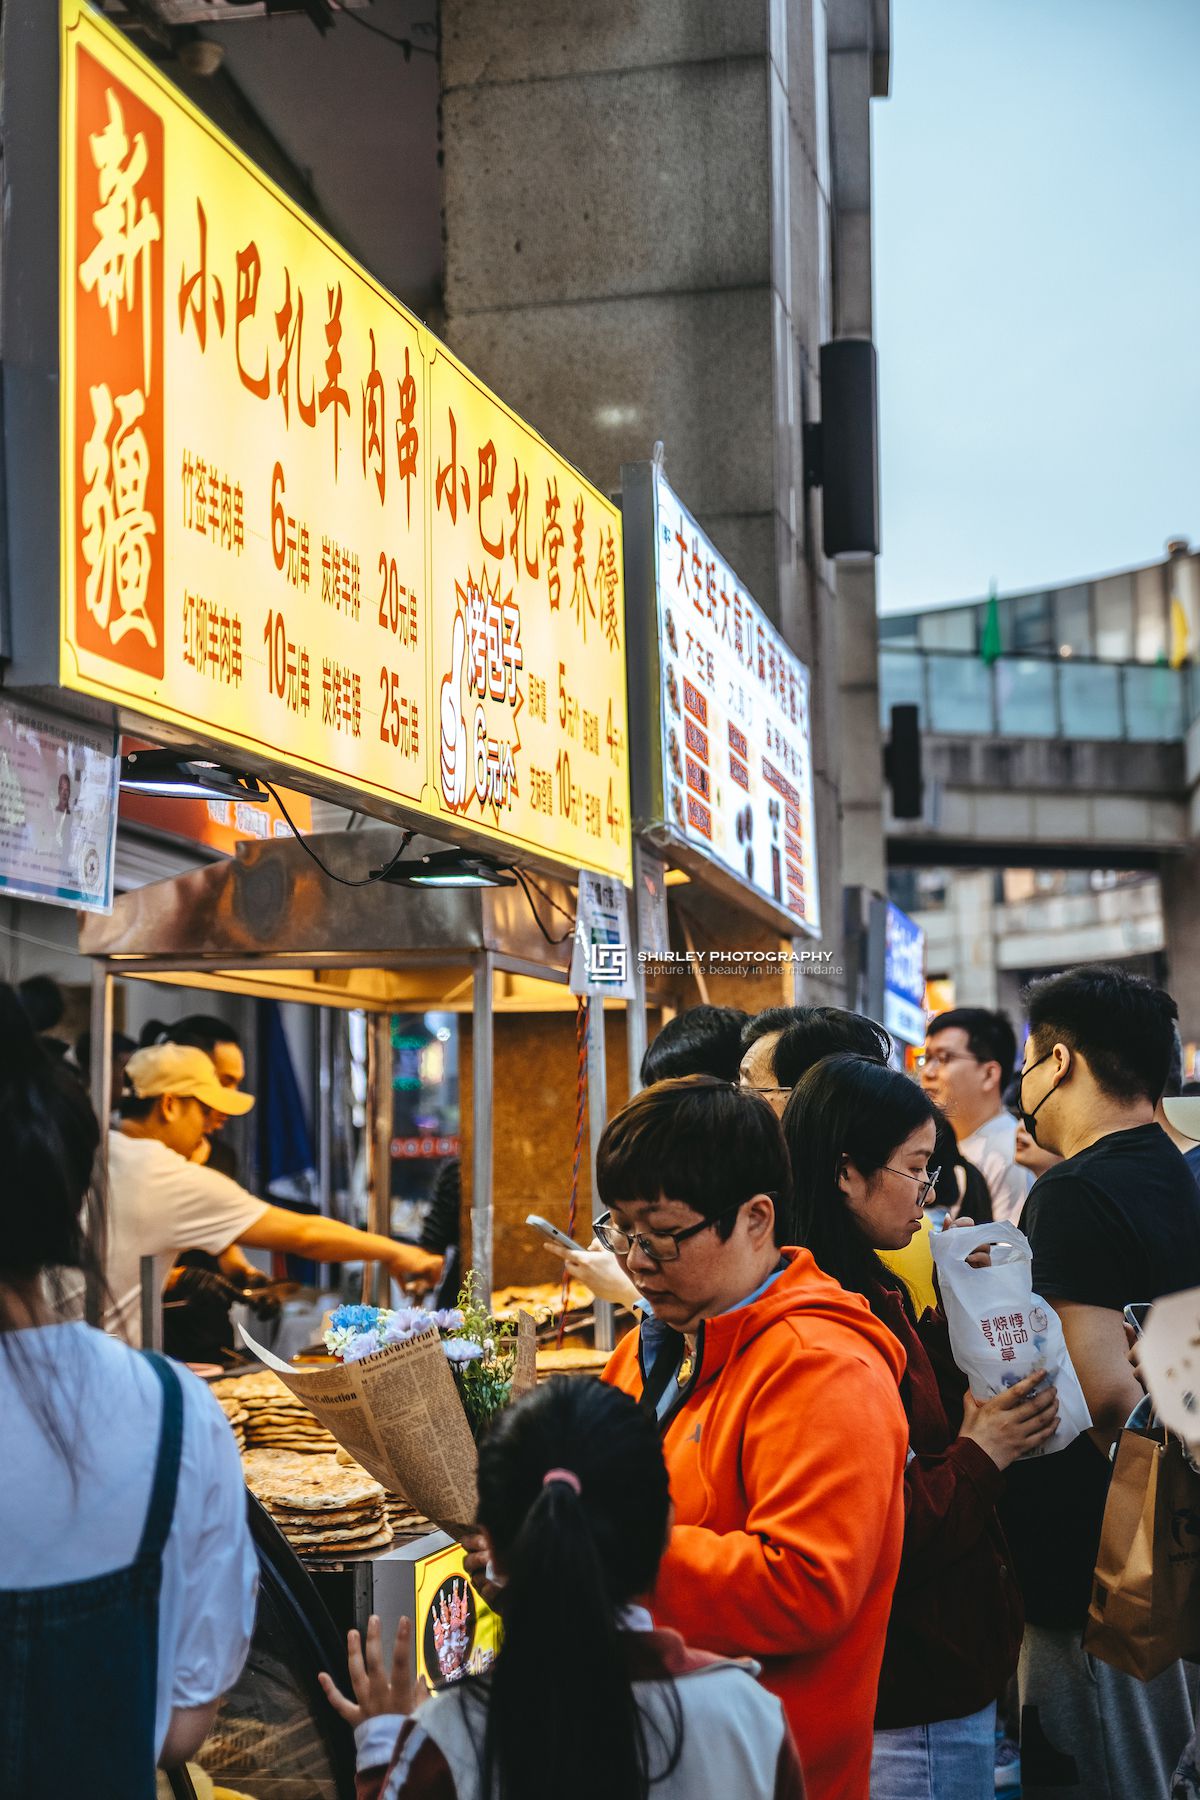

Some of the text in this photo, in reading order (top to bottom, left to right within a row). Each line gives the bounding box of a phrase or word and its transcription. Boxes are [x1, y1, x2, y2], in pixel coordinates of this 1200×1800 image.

[79, 88, 161, 648] 新疆
[178, 195, 420, 532] 小巴扎羊肉串
[181, 448, 244, 557] 竹签羊肉串
[320, 535, 361, 622] 炭烤羊排
[182, 588, 243, 689] 红柳羊肉串
[465, 579, 523, 707] 烤包子
[993, 1316, 1016, 1361] 烧仙草
